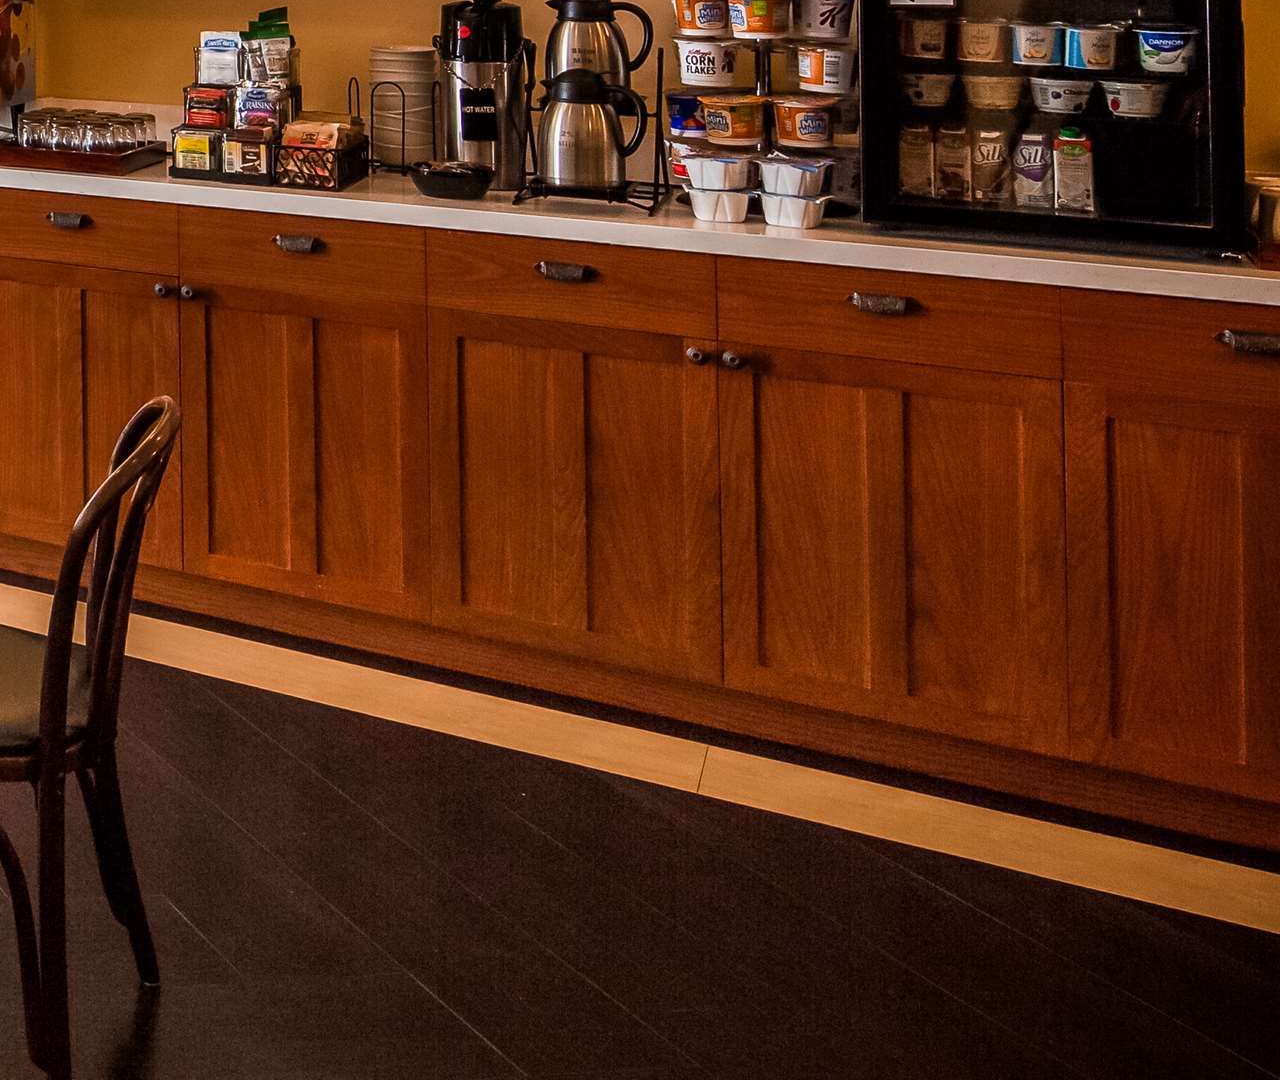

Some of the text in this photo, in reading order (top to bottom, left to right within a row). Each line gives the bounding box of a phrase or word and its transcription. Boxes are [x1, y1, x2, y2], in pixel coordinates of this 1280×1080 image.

[1148, 38, 1184, 46] DANNON
[685, 54, 716, 66] CORN
[686, 65, 717, 75] FLAKES
[973, 143, 1006, 163] Silk
[1016, 146, 1051, 167] Silk
